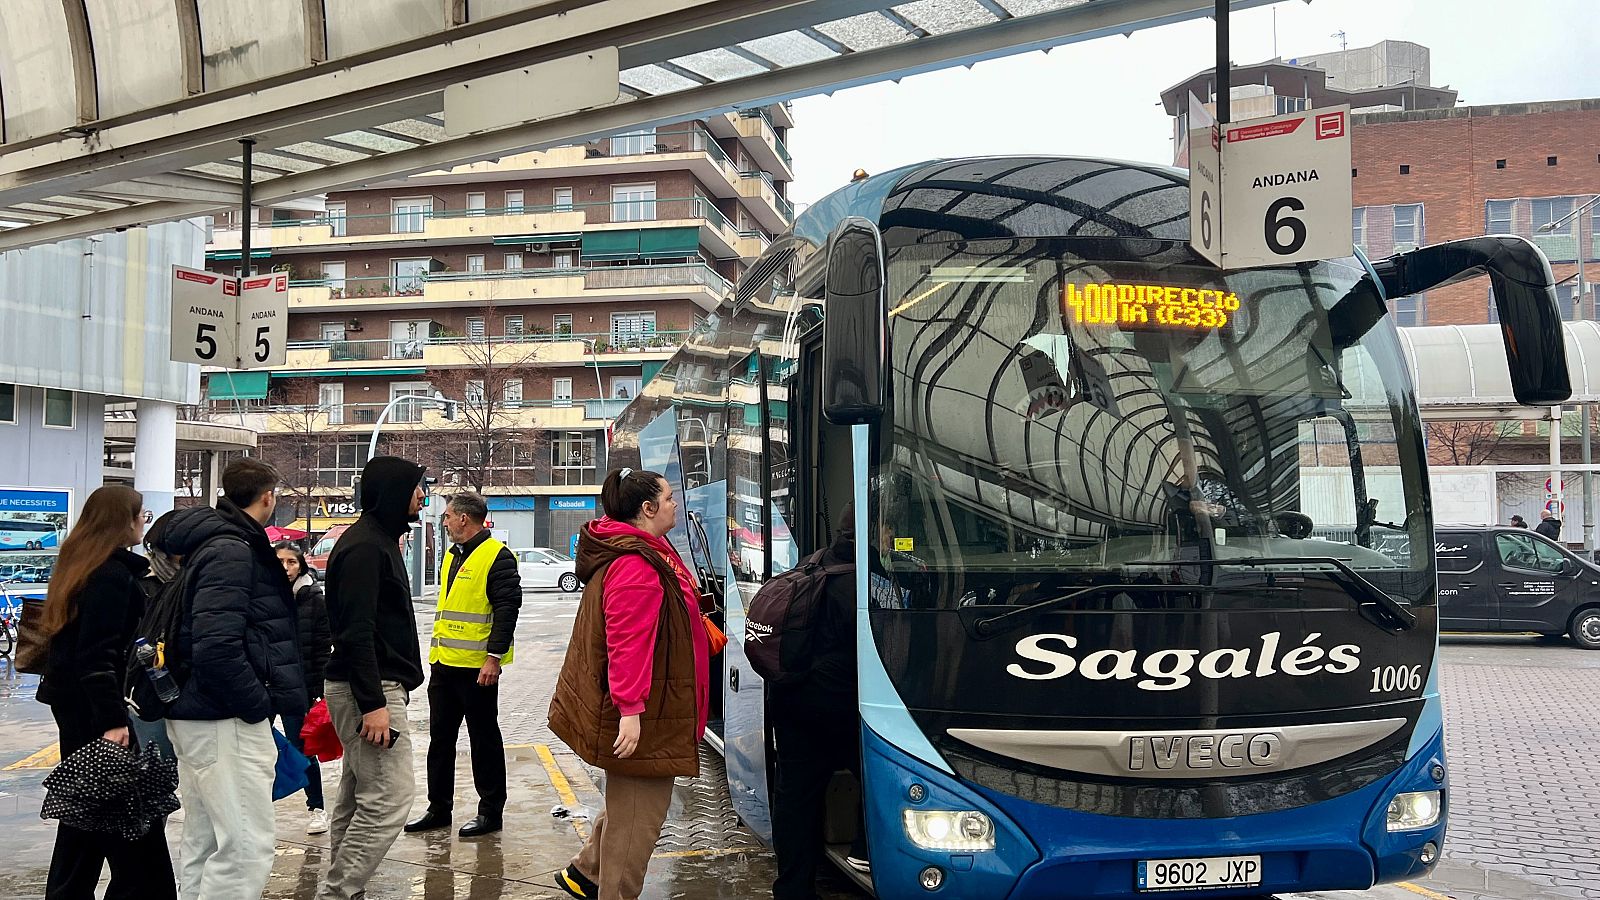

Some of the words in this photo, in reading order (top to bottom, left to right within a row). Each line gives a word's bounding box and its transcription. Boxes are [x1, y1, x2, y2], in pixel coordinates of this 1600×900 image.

[1252, 169, 1320, 189] ANDANA
[1201, 190, 1212, 250] 6
[1264, 196, 1307, 255] 6
[189, 305, 224, 319] ANDANA
[251, 310, 276, 320] ANDANA
[1067, 283, 1118, 324] 400
[1155, 305, 1227, 328] (C33)
[195, 323, 217, 360] 5
[254, 326, 270, 362] 5
[9, 499, 57, 507] NECESSITES
[314, 497, 356, 517] Aries
[745, 617, 773, 633] Reebok
[1006, 631, 1362, 691] Sagalés
[1369, 664, 1422, 693] 1006
[1128, 732, 1282, 770] IVECO
[1155, 862, 1207, 885] 9602
[1219, 860, 1257, 883] JXP
